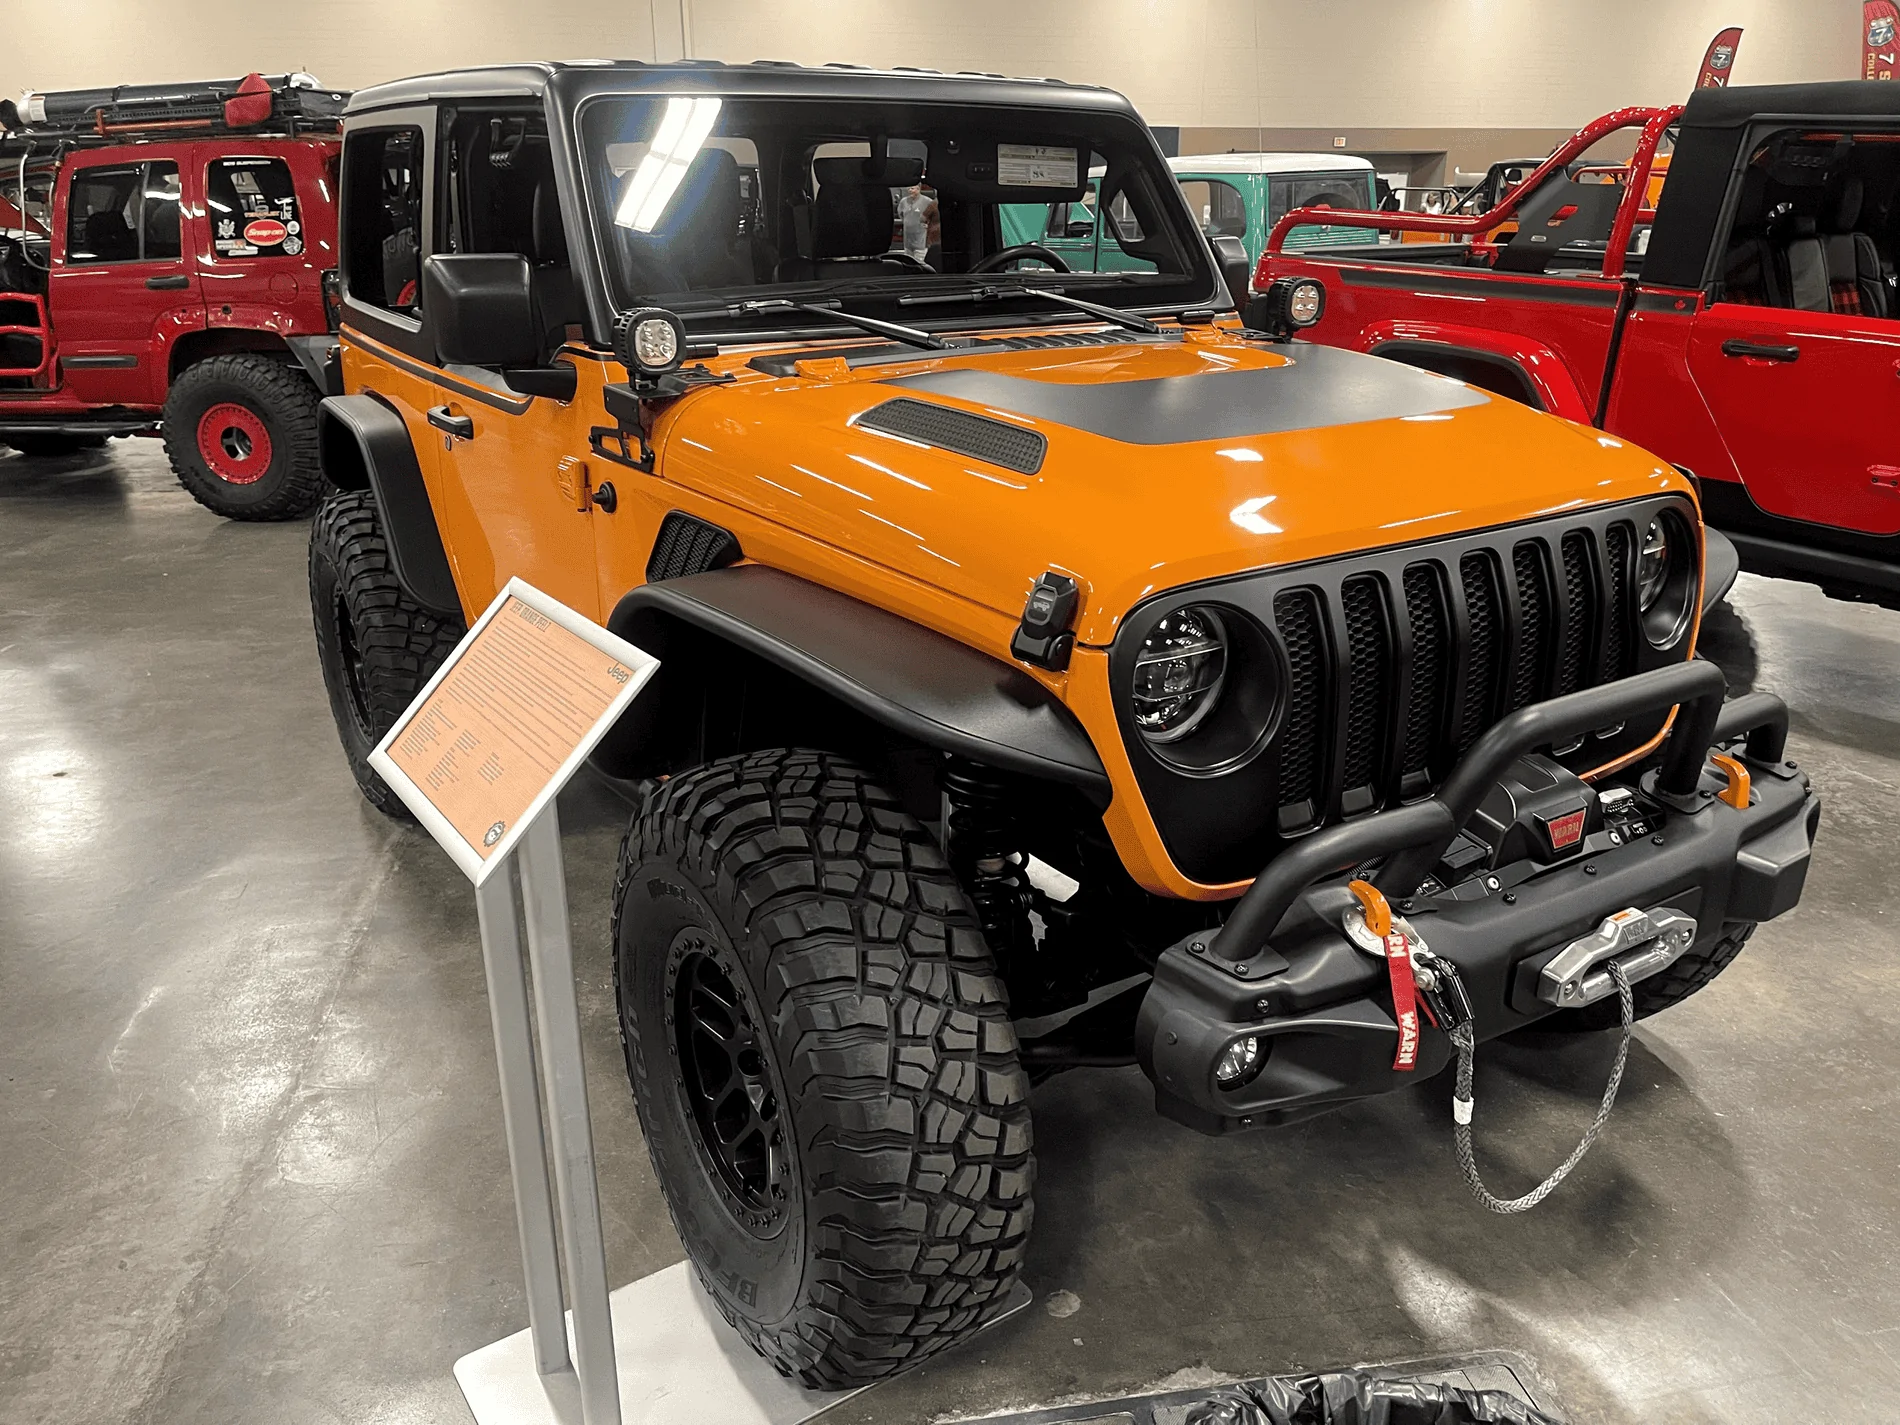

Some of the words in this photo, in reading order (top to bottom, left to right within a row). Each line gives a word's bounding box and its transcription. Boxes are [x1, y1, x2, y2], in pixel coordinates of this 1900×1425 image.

[1878, 53, 1894, 64] 7
[607, 661, 629, 684] Jeep
[1399, 1011, 1416, 1063] WARN
